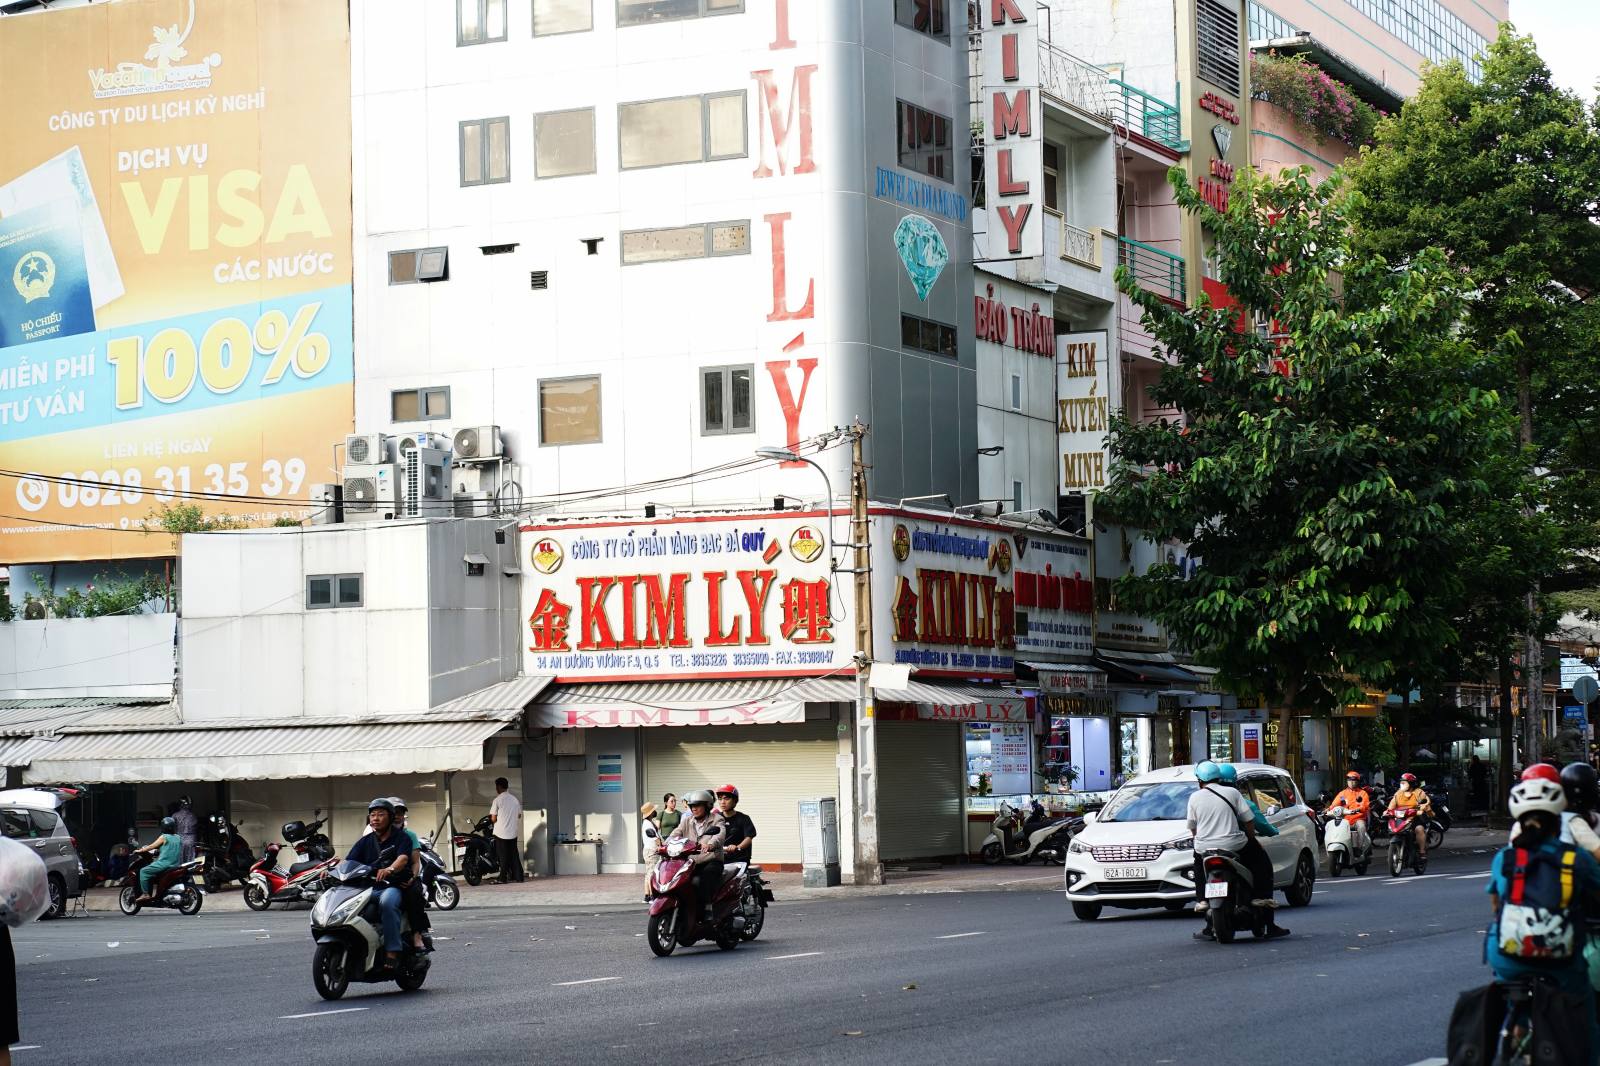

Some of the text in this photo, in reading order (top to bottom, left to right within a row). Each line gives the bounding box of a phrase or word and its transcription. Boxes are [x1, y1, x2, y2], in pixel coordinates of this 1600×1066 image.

[49, 87, 266, 131] CÔNG TY DU LỊCH KỲ NGHỈ
[118, 144, 208, 175] DỊCH VỤ
[119, 163, 333, 255] VISA
[213, 252, 335, 285] CÁC NƯỚC
[25, 324, 61, 340] PASSPORT
[55, 346, 96, 382] PHÍ
[106, 300, 331, 411] 100%
[1067, 342, 1097, 378] KIM
[0, 384, 86, 425] TƯ VẤN
[1058, 380, 1108, 434] XUYẾN
[57, 457, 306, 509] 0828 31 35 39
[1063, 452, 1105, 488] MINH
[539, 542, 554, 553] KL
[603, 538, 618, 559] TY
[670, 530, 698, 555] VÀNG
[725, 528, 740, 553] ĐÁ
[741, 527, 767, 552] QUÝ
[798, 530, 814, 540] KL
[576, 538, 783, 651] KIM LÝ
[916, 568, 966, 645] KIM
[529, 587, 573, 652] 金
[537, 656, 547, 669] 34
[550, 655, 562, 669] AN
[563, 707, 674, 727] KIM
[932, 701, 1014, 721] KIM LÝ
